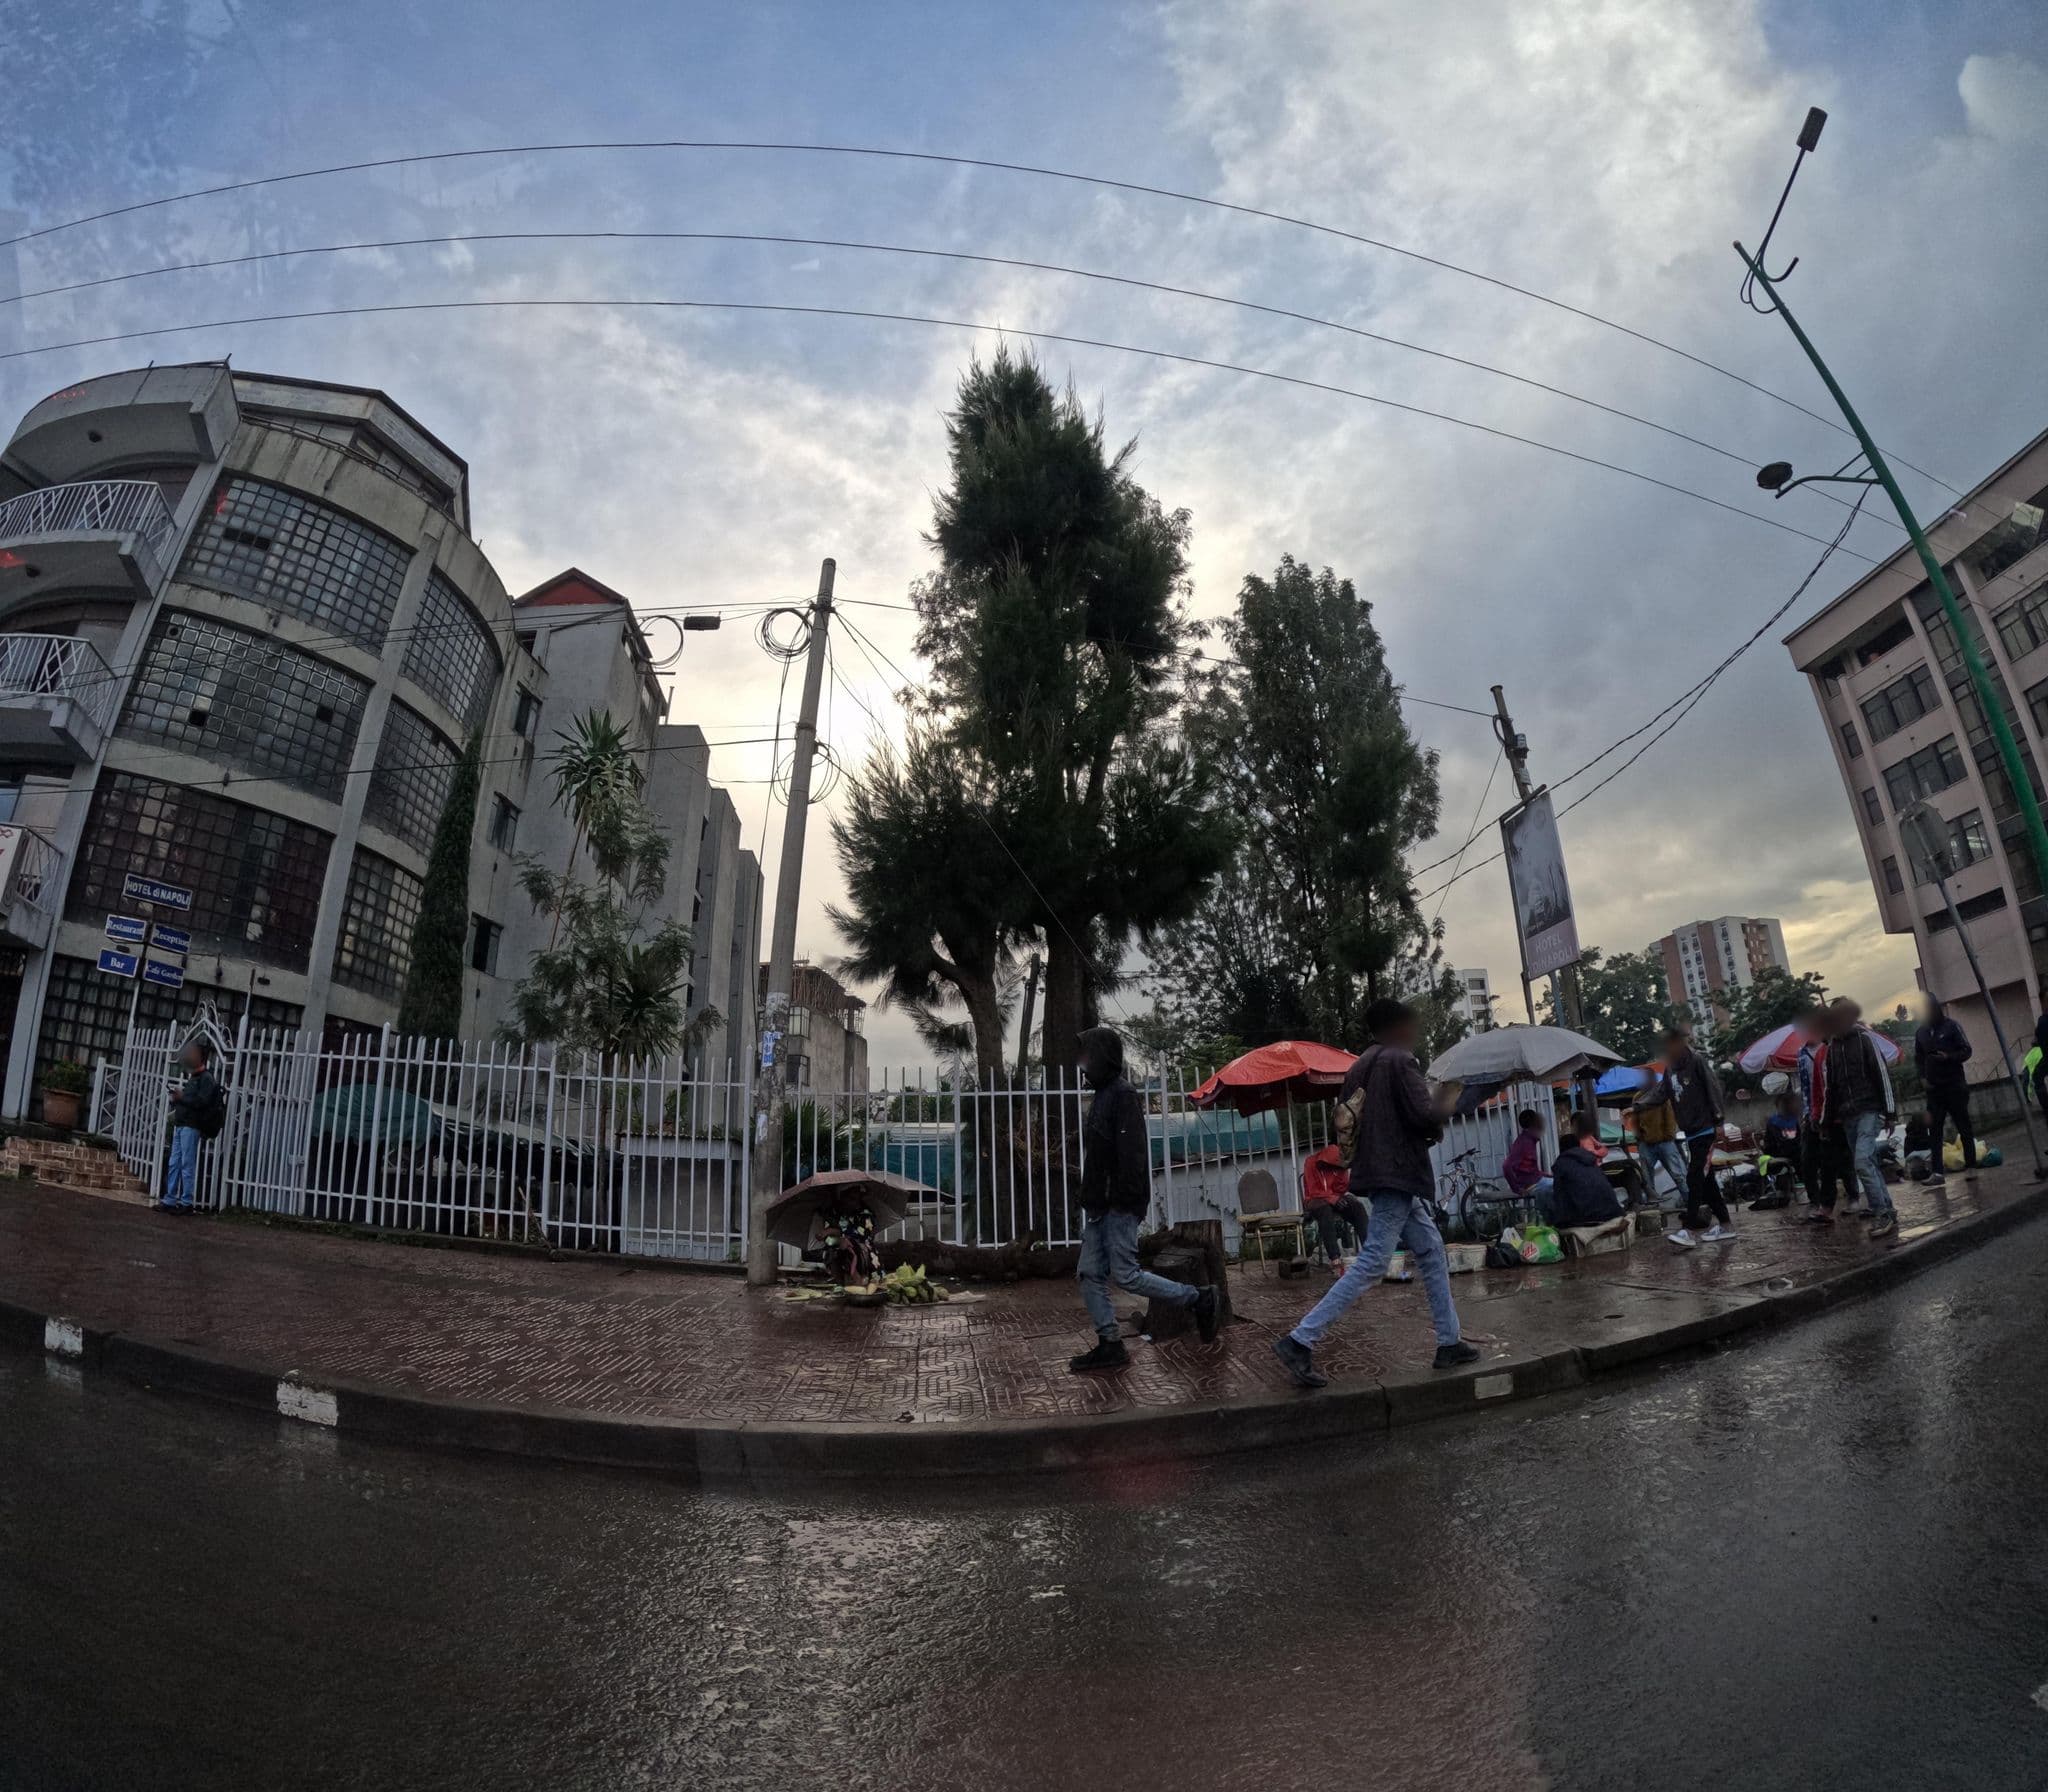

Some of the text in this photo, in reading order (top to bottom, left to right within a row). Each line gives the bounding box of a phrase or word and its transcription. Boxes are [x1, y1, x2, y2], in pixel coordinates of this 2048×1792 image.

[126, 881, 190, 905] HOTEL di NAPOLI
[1536, 931, 1562, 953] HOTEL
[110, 957, 125, 969] Bar
